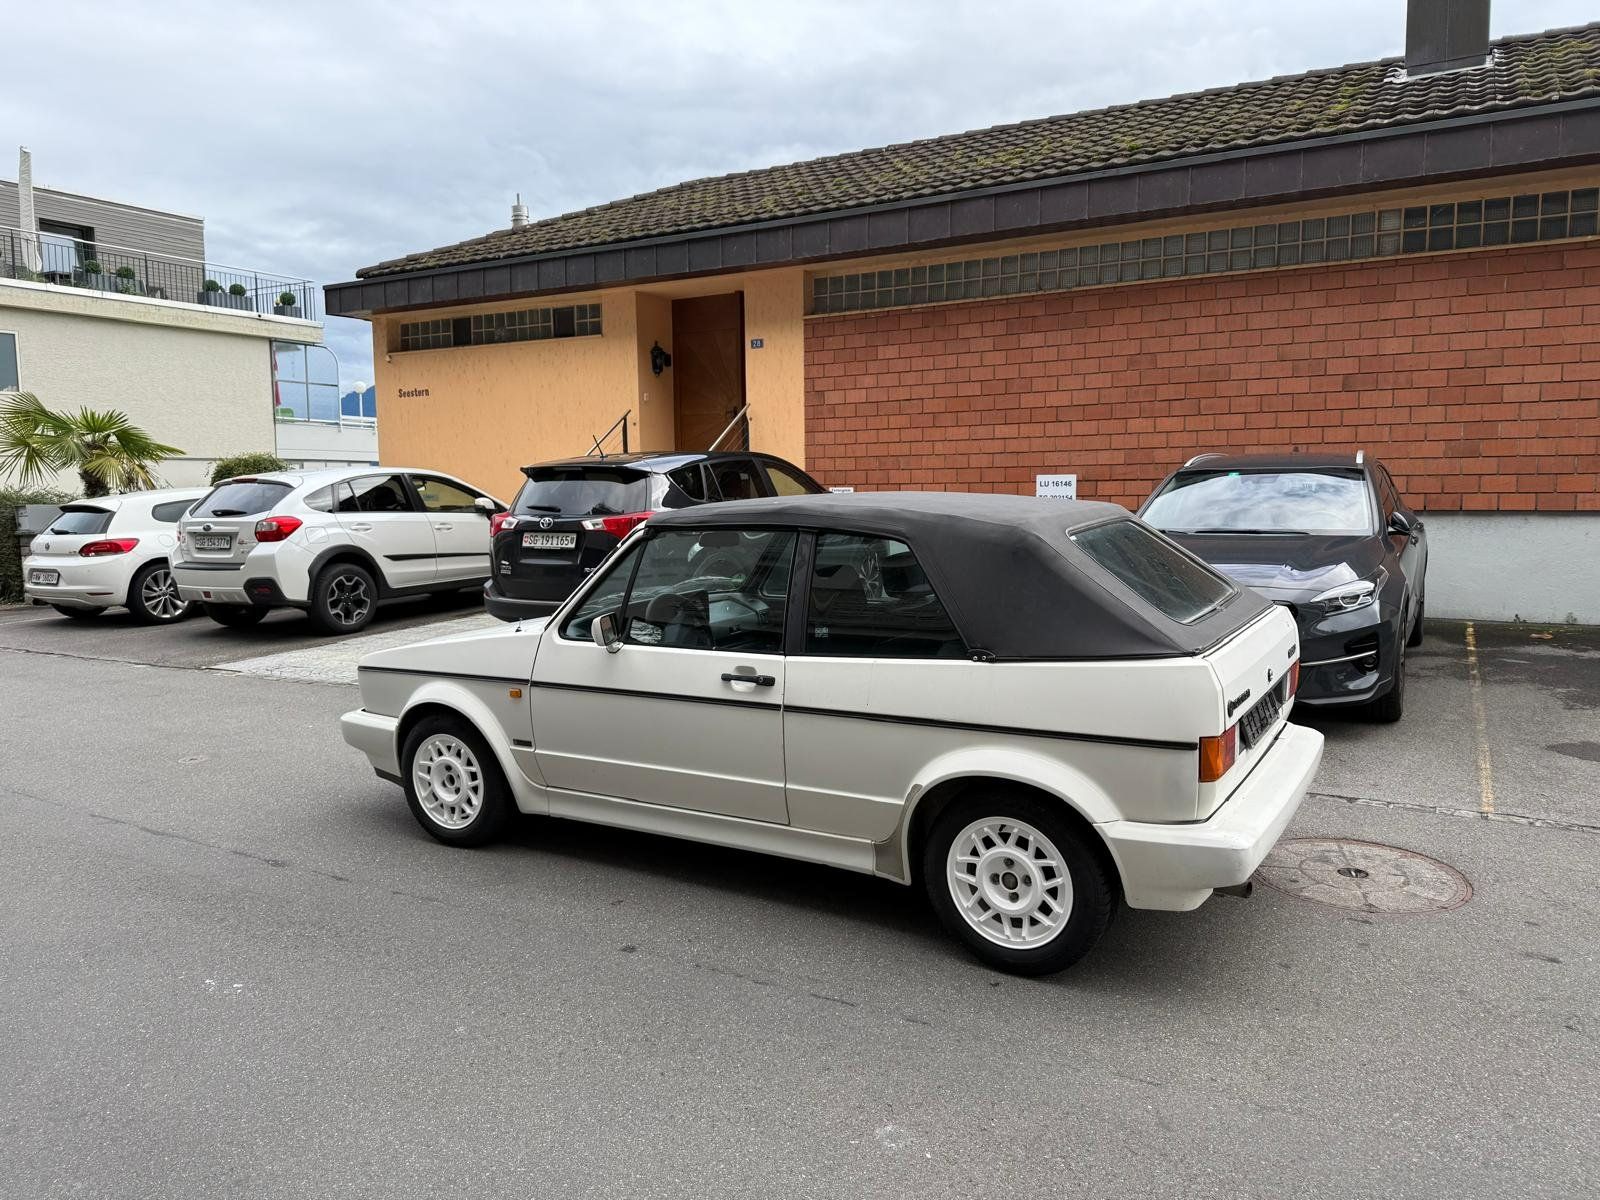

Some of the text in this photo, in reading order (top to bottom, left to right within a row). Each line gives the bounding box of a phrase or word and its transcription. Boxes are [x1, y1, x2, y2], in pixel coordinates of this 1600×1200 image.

[398, 388, 430, 398] Seestern
[1052, 480, 1072, 488] 16146
[528, 535, 570, 546] SG 191165
